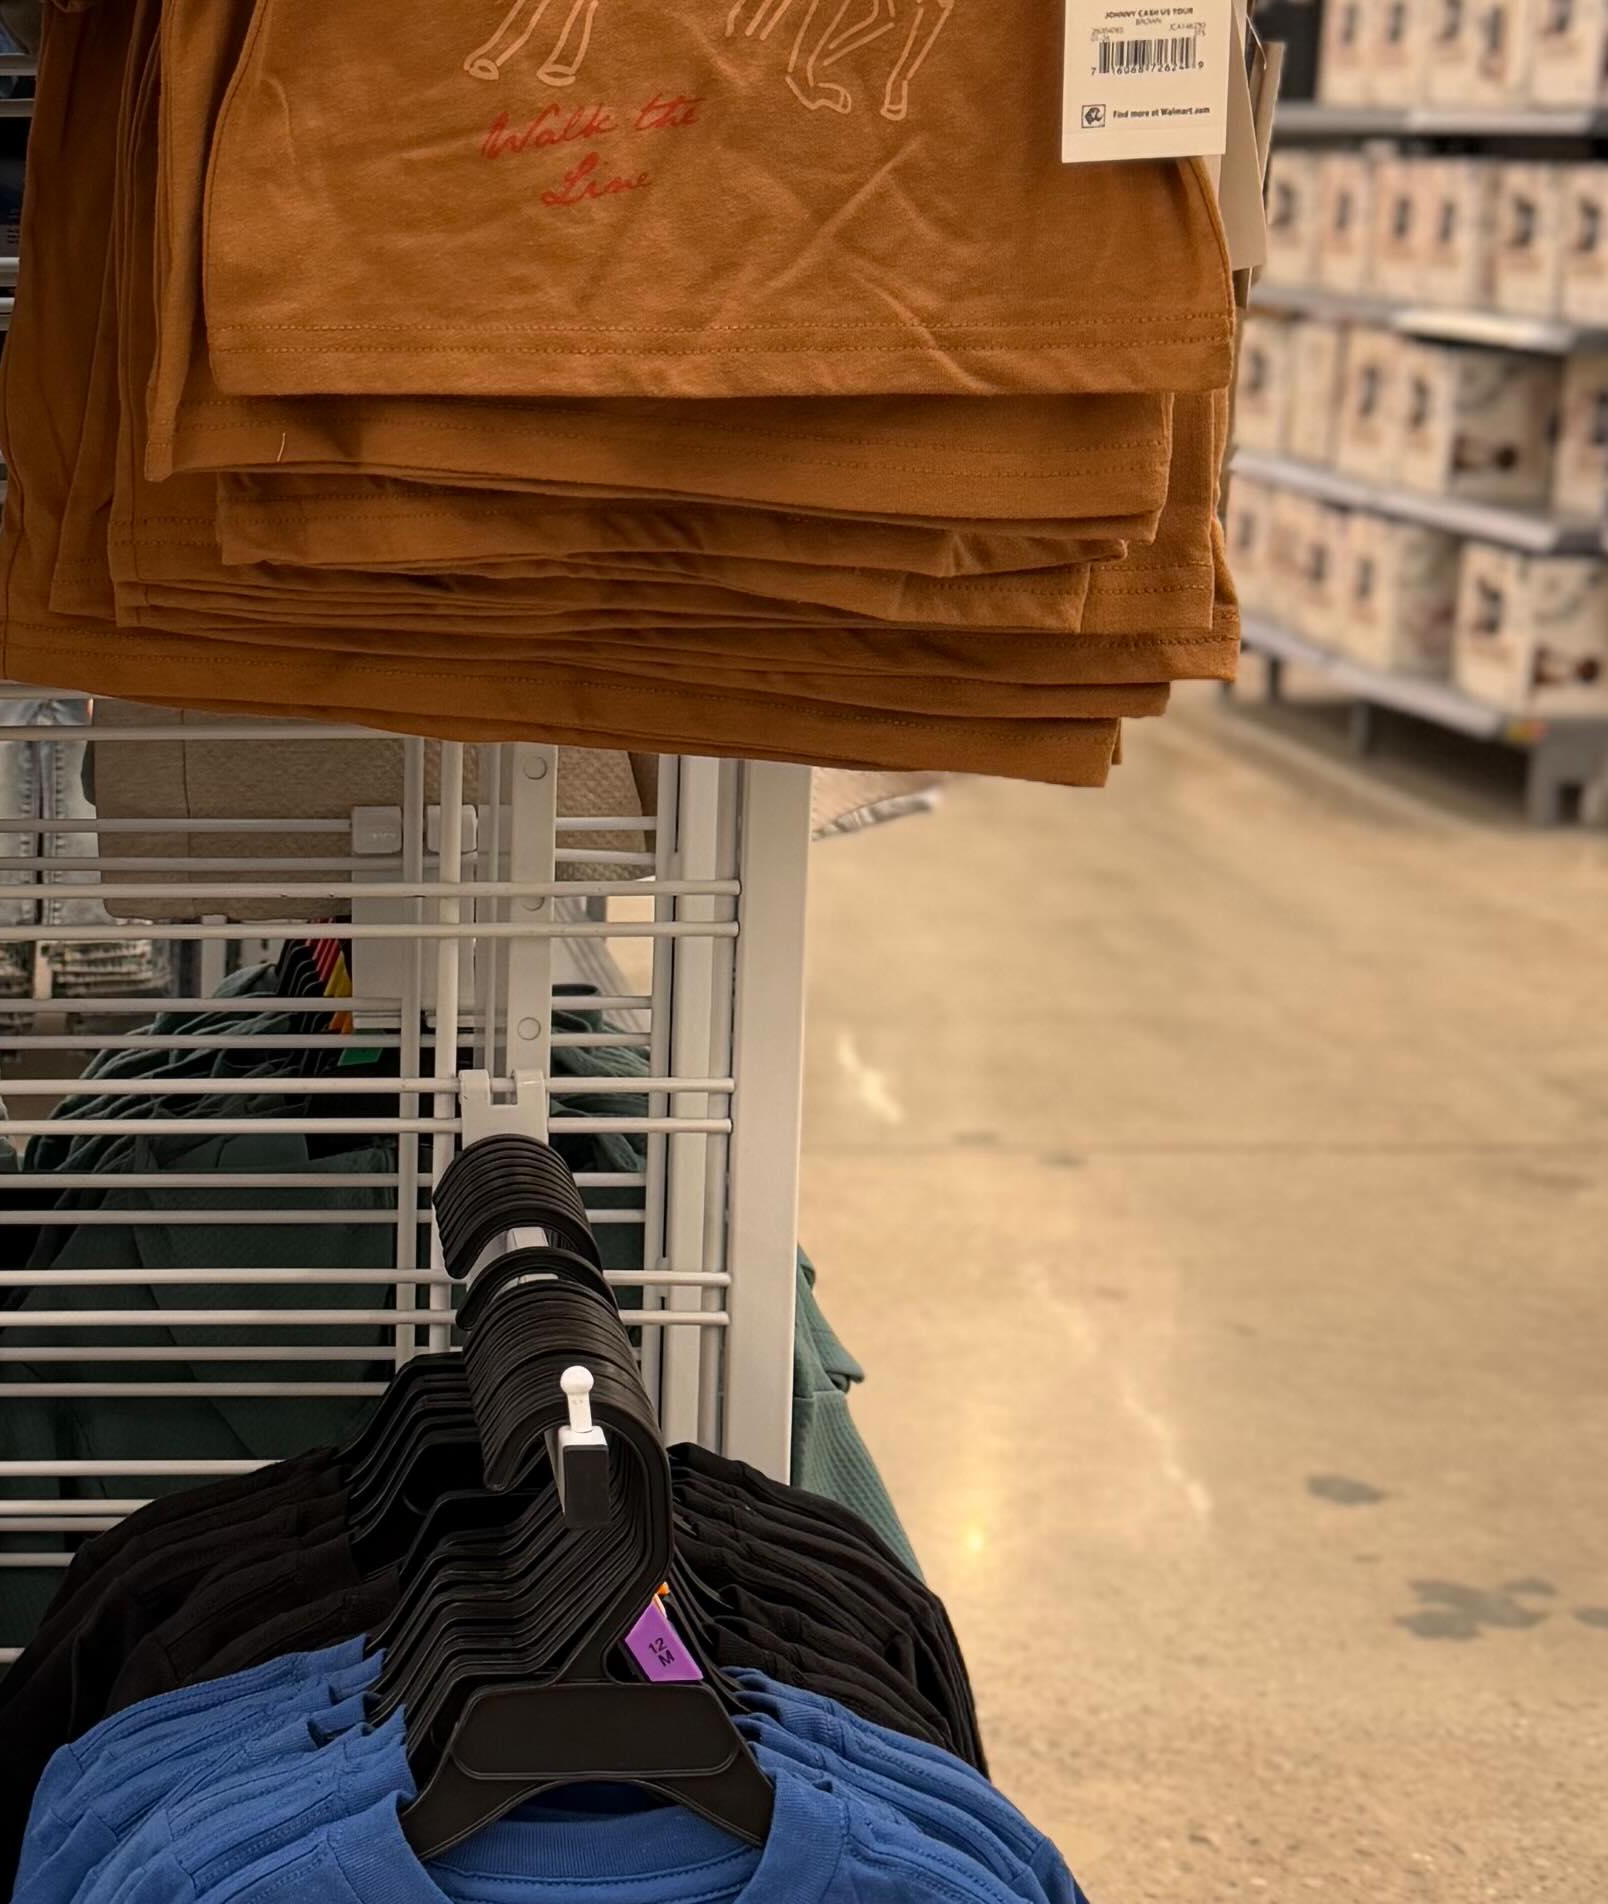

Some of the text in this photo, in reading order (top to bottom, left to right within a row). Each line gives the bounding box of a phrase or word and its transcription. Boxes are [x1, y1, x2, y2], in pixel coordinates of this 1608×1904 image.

[482, 103, 618, 160] Walk
[647, 1636, 668, 1657] 12
[657, 1650, 675, 1669] M
